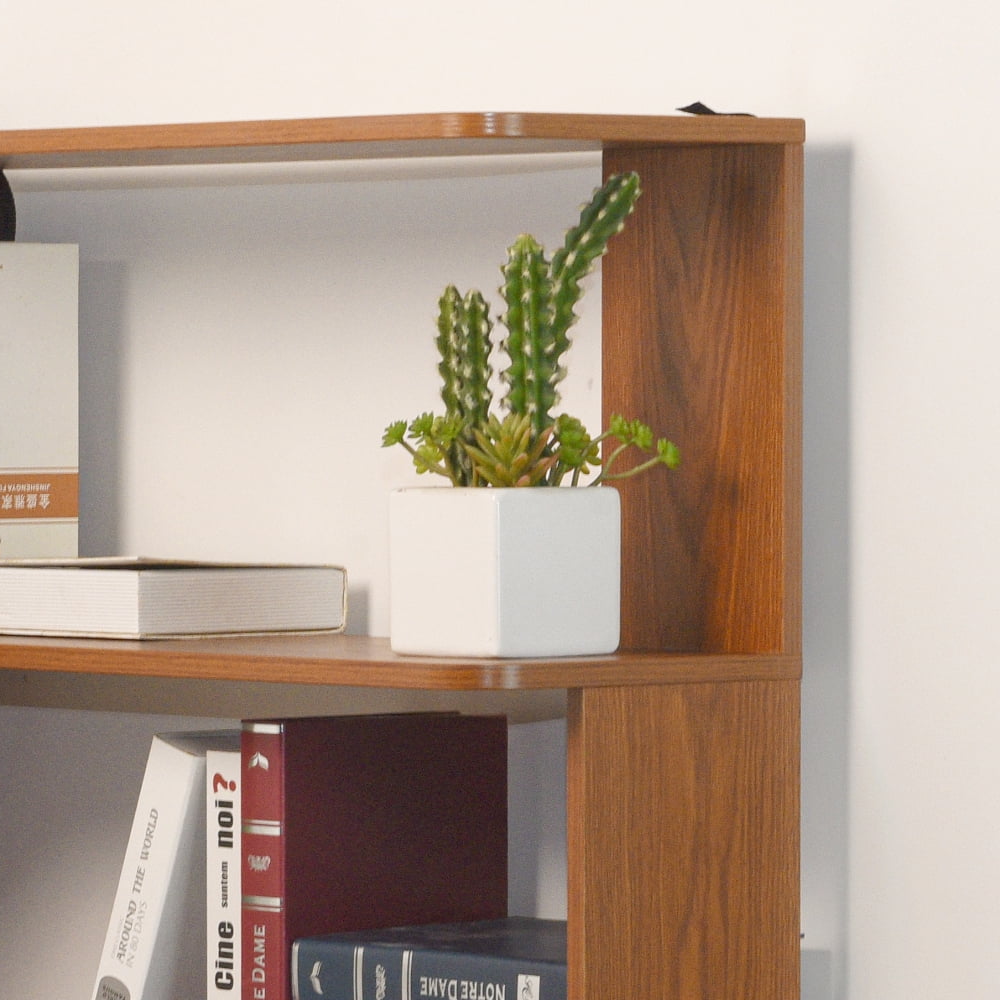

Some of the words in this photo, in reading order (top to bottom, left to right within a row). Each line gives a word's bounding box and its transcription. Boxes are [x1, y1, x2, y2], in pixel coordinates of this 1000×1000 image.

[116, 900, 137, 964] AROUND
[132, 865, 146, 895] THE
[140, 808, 159, 860] WORLD
[221, 861, 229, 908] suntem
[134, 901, 148, 935] DAYS
[215, 921, 234, 991] Cine
[251, 925, 266, 983] DAME
